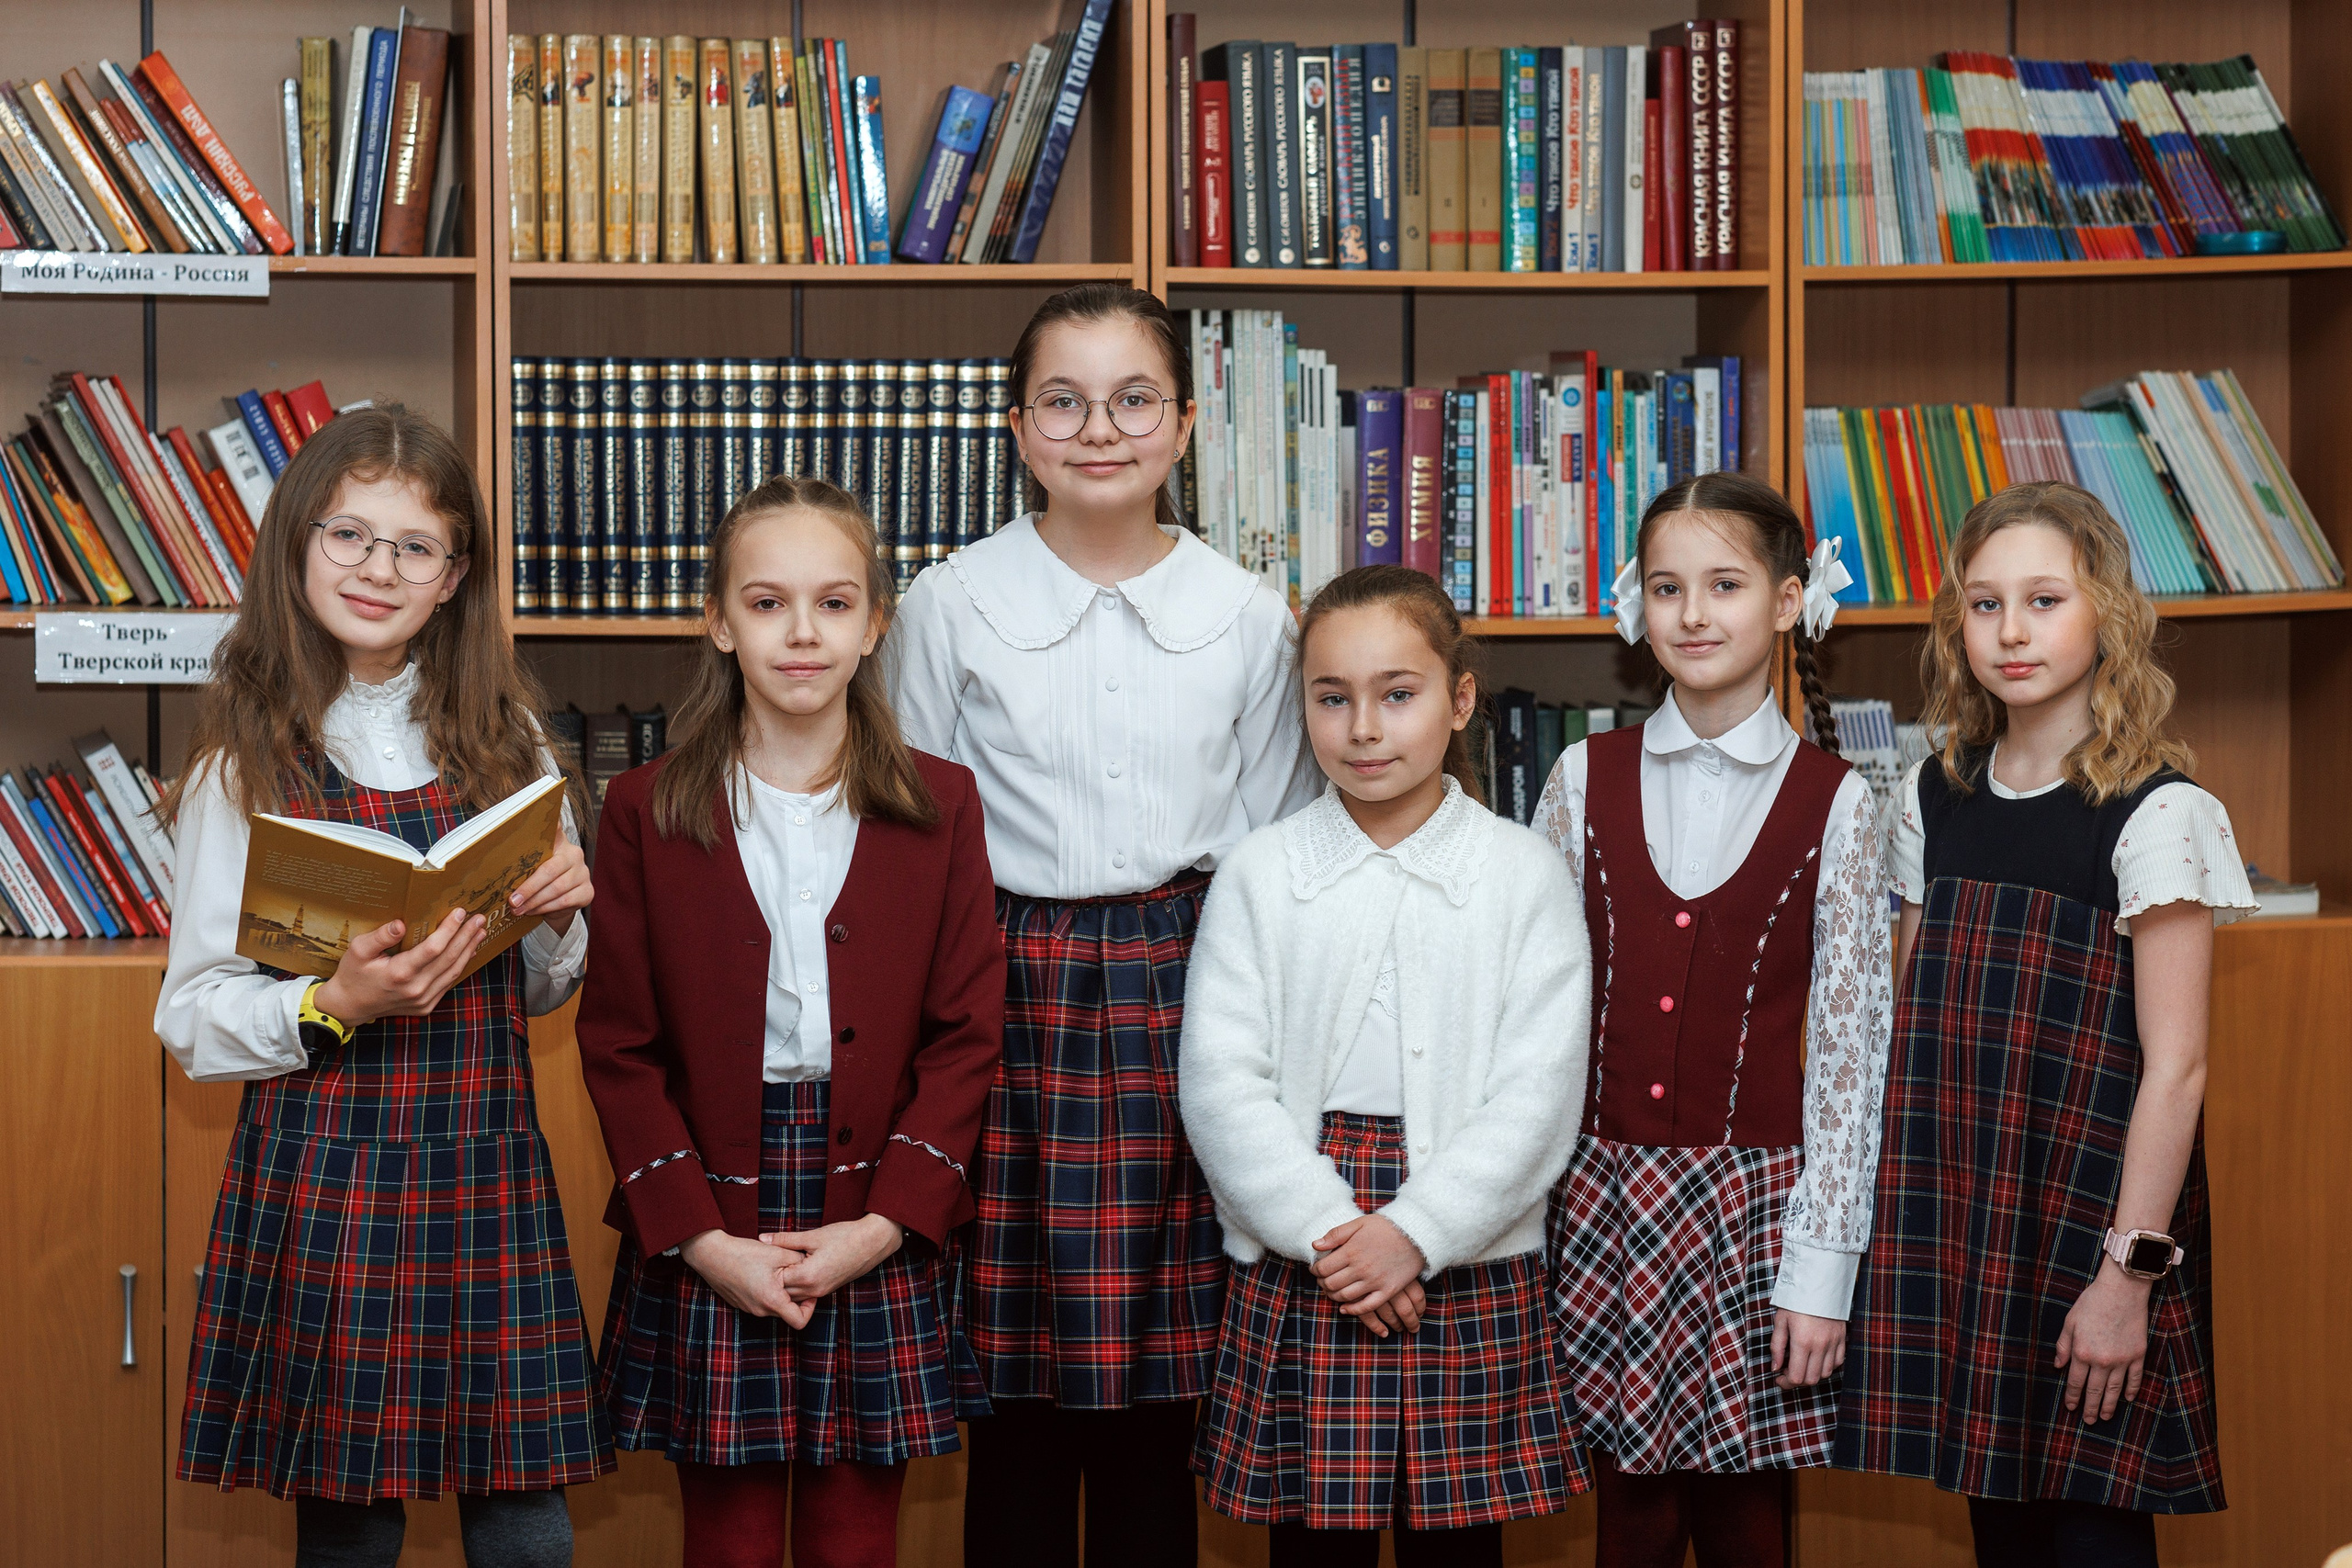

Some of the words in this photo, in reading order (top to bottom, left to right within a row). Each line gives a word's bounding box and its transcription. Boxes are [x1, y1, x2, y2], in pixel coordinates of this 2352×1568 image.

[375, 39, 389, 79] ПЕРИОДА
[1240, 51, 1252, 88] ЯЗЫКА
[1272, 48, 1284, 85] ЯЗЫКА
[1691, 54, 1710, 104] СССР
[1717, 50, 1735, 101] СССР
[1545, 68, 1559, 110] такой
[1567, 67, 1579, 107] такой
[1587, 73, 1600, 114] такой
[178, 101, 211, 141] ДОМ
[367, 80, 383, 152] ПОСЛЕВОЕННОГО
[1241, 88, 1254, 142] РУССКОГО
[1273, 85, 1286, 140] РУССКОГО
[1545, 111, 1559, 137] Кто
[1567, 109, 1579, 134] Кто
[1586, 116, 1600, 141] Кто
[1692, 108, 1711, 169] КНИГА
[1717, 105, 1735, 165] КНИГА
[201, 134, 255, 206] РУССКИЙ
[361, 153, 375, 203] СЛЕДСТВИЯ
[1243, 142, 1255, 189] СЛОВАРЬ
[1275, 141, 1288, 188] СЛОВАРЬ
[1547, 140, 1559, 181] такое
[1568, 138, 1579, 179] такое
[1587, 144, 1600, 186] такое
[1546, 183, 1560, 211] Что
[1567, 182, 1580, 209] Что
[1585, 188, 1599, 214] Что
[1693, 173, 1713, 257] КРАСНАЯ
[1717, 169, 1736, 254] КРАСНАЯ
[356, 205, 369, 248] ВЕТЕРАНЫ
[21, 263, 66, 279] Моя
[74, 263, 154, 283] Родина
[174, 264, 250, 281] Россия
[1566, 241, 1578, 267] Том
[1586, 242, 1599, 270] Том
[1364, 446, 1389, 547] ФИЗИКА
[1409, 455, 1434, 542] ХИМИЯ
[519, 561, 526, 576] 1
[550, 561, 560, 576] 2
[582, 562, 590, 578] 3
[612, 562, 621, 576] 4
[641, 563, 651, 578] 5
[671, 562, 680, 577] 6
[101, 623, 168, 644] Тверь
[58, 651, 164, 674] Тверской
[170, 655, 209, 673] кра
[14, 860, 33, 885] КРАЙ
[9, 883, 40, 928] ТВЕРСКОЙ
[28, 884, 60, 928] ТВЕРСКОЙ
